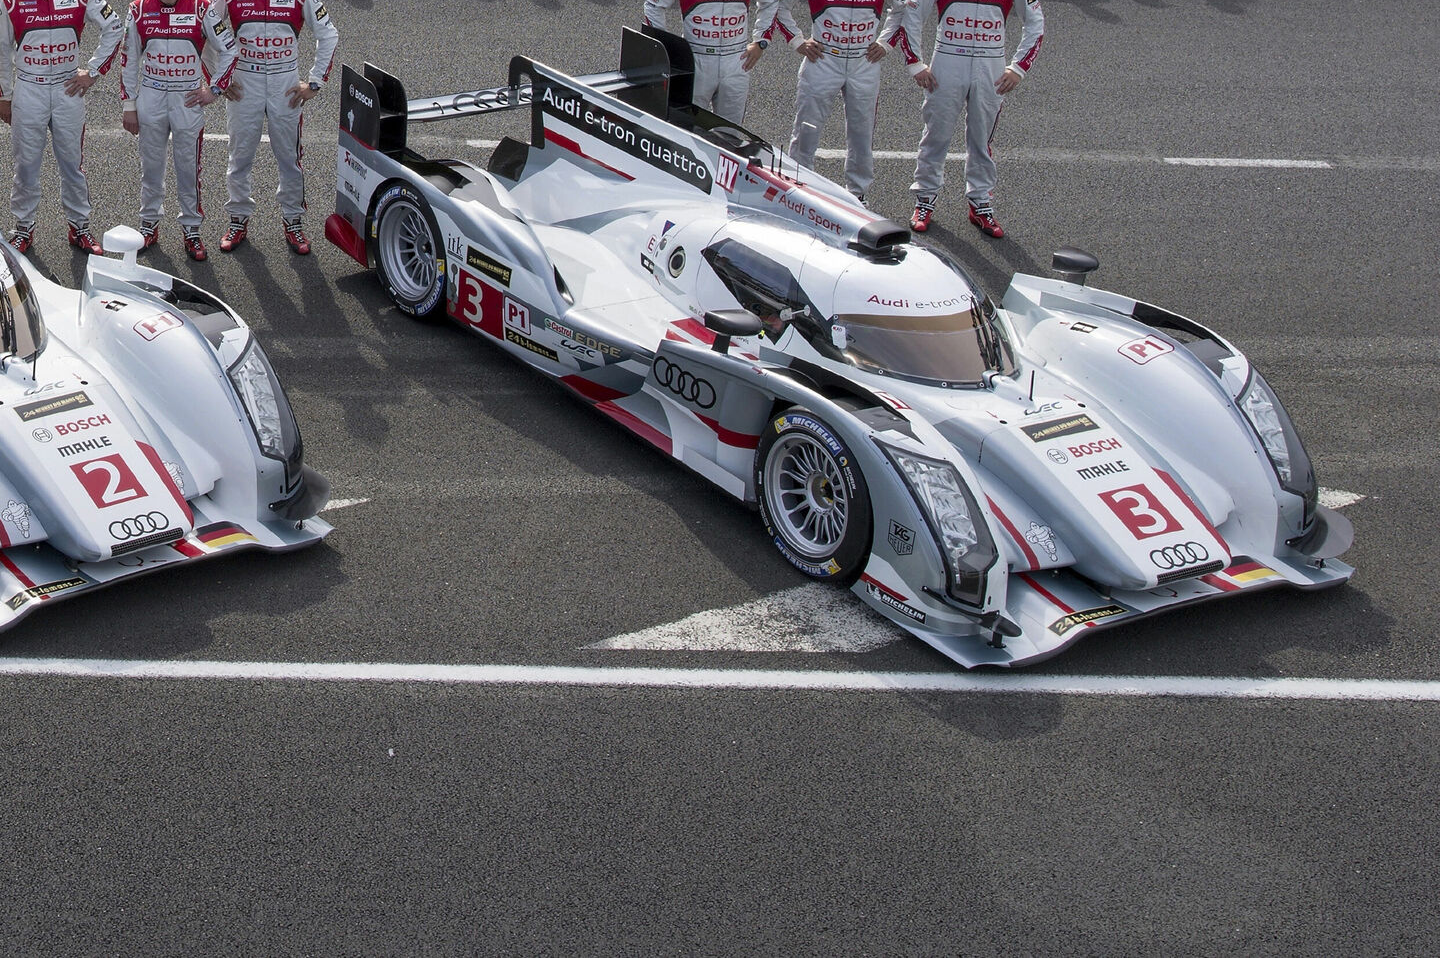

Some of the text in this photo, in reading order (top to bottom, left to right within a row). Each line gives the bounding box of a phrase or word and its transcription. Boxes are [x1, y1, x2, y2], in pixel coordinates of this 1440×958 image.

[54, 13, 73, 21] Sport
[692, 14, 745, 27] e-tron
[823, 19, 875, 32] e-tron
[945, 16, 1002, 30] e-tron
[172, 27, 193, 35] Sport
[692, 27, 744, 39] quattro
[822, 31, 874, 44] quattro
[944, 30, 1002, 42] quattro
[22, 41, 76, 54] e-tron
[239, 36, 293, 48] e-tron
[24, 54, 75, 66] quattro
[146, 52, 196, 64] e-tron
[240, 47, 292, 60] quattro
[145, 64, 196, 77] quattro
[354, 89, 373, 109] BOSCH
[542, 87, 706, 180] Audi e-tron quattro
[716, 155, 738, 190] HY
[779, 194, 842, 235] Audi Sport
[448, 233, 463, 256] itk
[463, 277, 483, 323] 3
[867, 295, 960, 309] Audi e-tron
[508, 302, 526, 329] P1
[550, 321, 622, 358] Castrol EDGE
[560, 339, 597, 358] WEC
[1127, 340, 1165, 358] P1
[1024, 401, 1063, 416] WEC
[55, 413, 112, 436] BOSCH
[791, 416, 841, 452] MICHELIN
[57, 435, 112, 458] MAHLE
[1067, 437, 1122, 458] BOSCH
[1076, 460, 1130, 480] MAHLE
[81, 460, 138, 504] 2
[1111, 490, 1168, 534] 3
[893, 524, 911, 542] TAG
[775, 542, 822, 575] MICHELIN
[882, 593, 925, 621] MICHELIN
